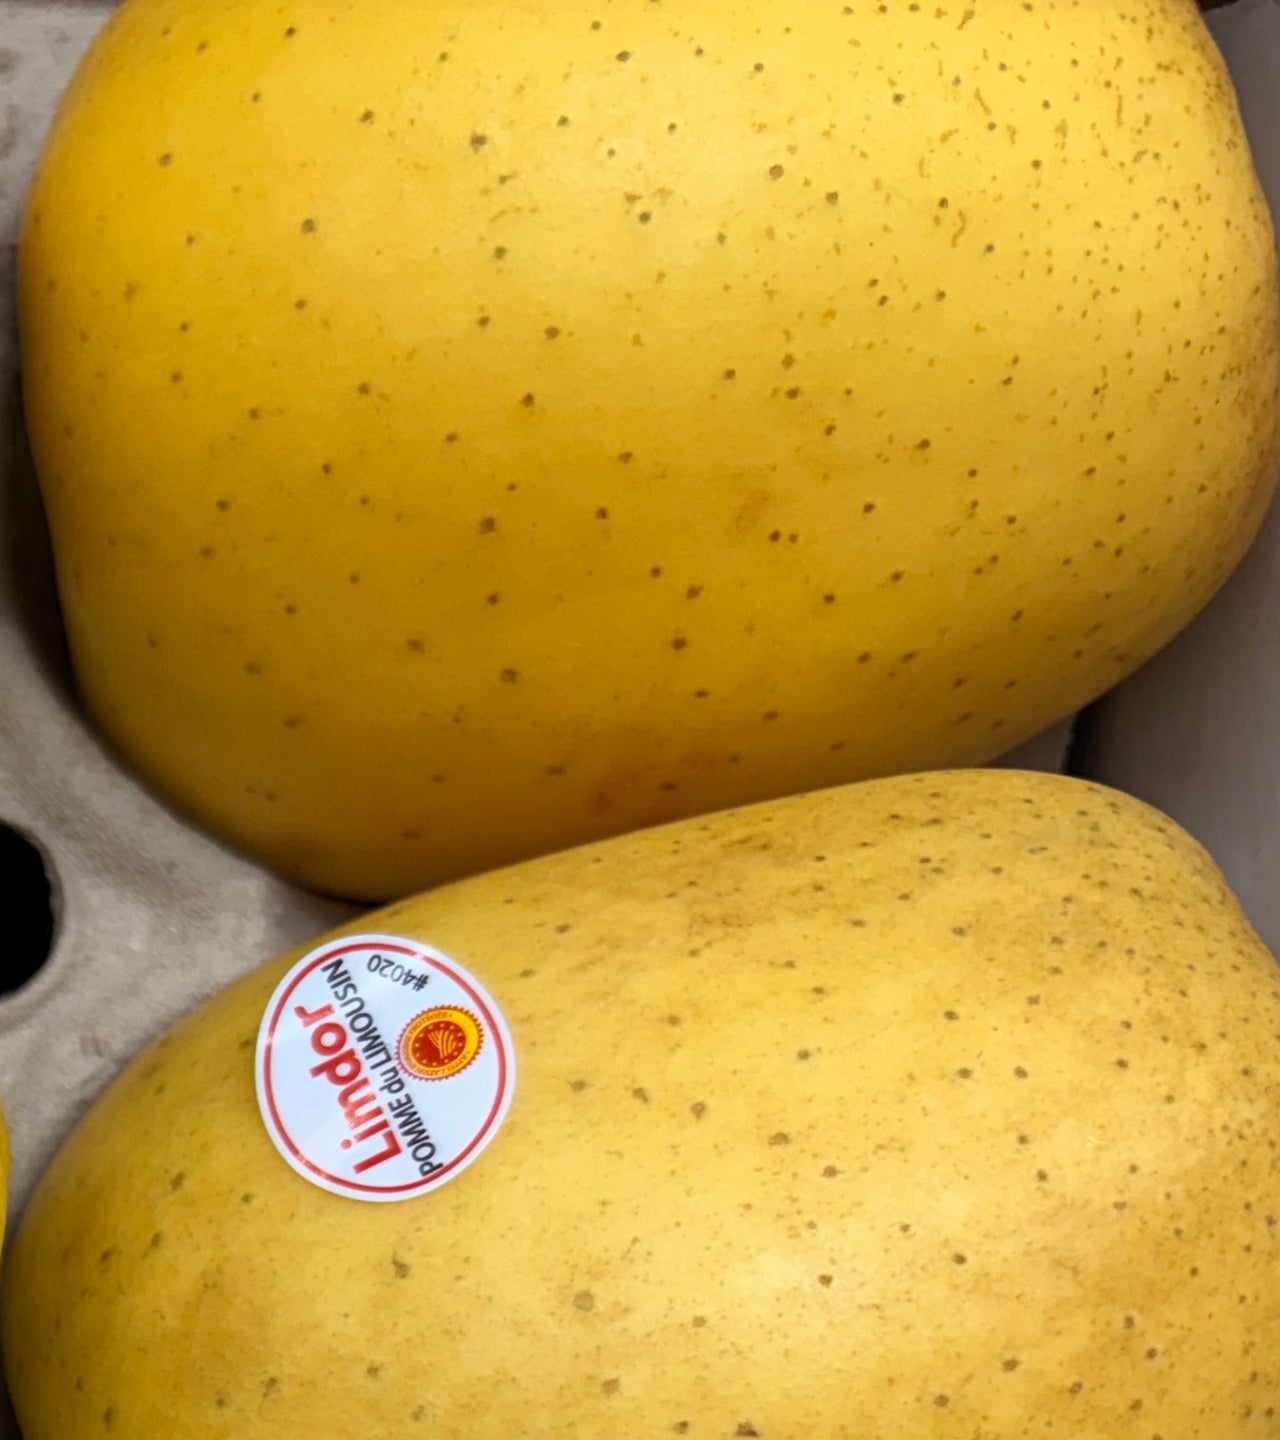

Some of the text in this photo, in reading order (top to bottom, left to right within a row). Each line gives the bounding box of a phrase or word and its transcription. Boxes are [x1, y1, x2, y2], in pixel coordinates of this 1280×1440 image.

[321, 958, 392, 1071] LIMOUSIN
[367, 954, 430, 992] #4020
[293, 1003, 402, 1175] Limdor
[378, 1066, 405, 1095] du
[388, 1093, 444, 1177] POMME
